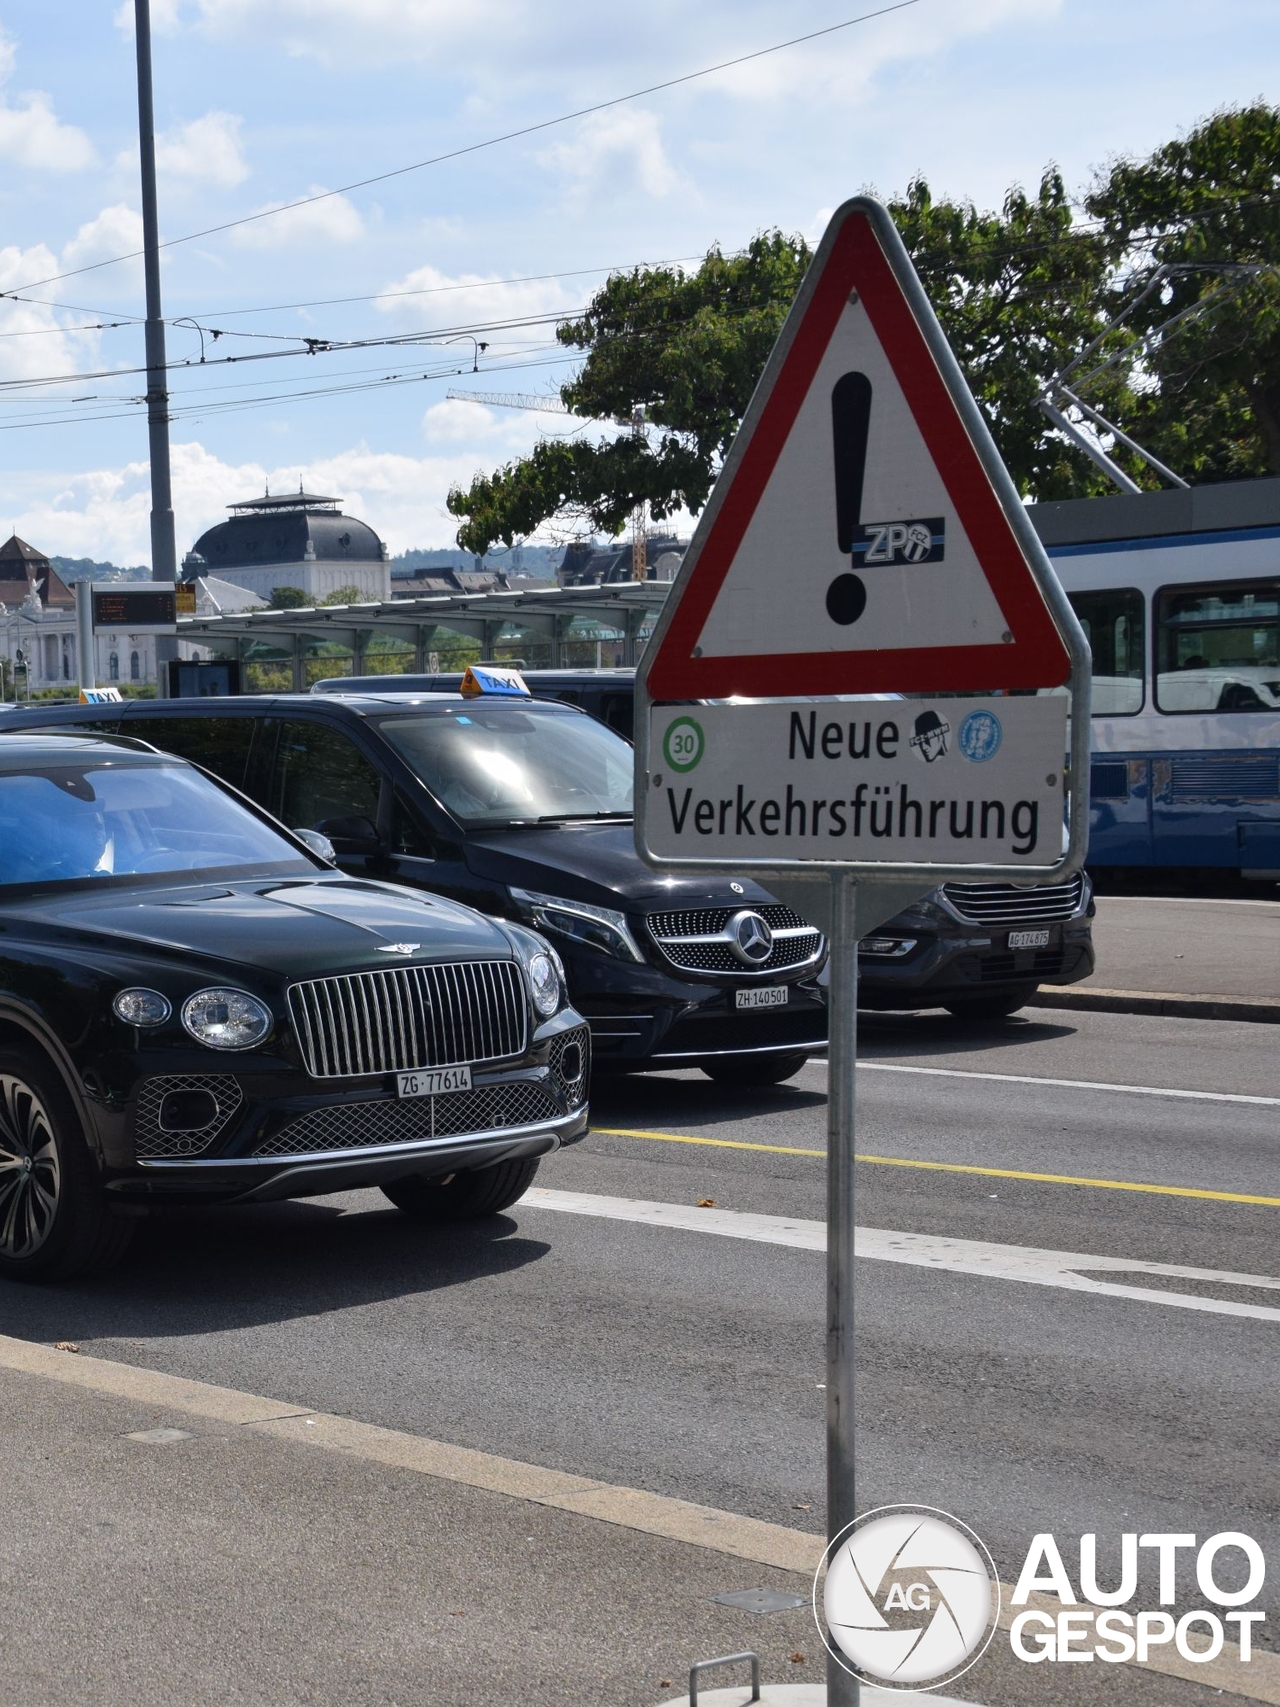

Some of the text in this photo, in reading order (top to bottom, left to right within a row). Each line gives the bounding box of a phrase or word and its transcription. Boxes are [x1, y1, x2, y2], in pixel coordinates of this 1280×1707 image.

[910, 528, 928, 545] FCZ
[480, 675, 520, 691] TAXI
[87, 692, 118, 703] TAXI
[673, 734, 695, 754] 30
[789, 710, 900, 760] Neue
[666, 783, 1039, 856] Verkehrsführung
